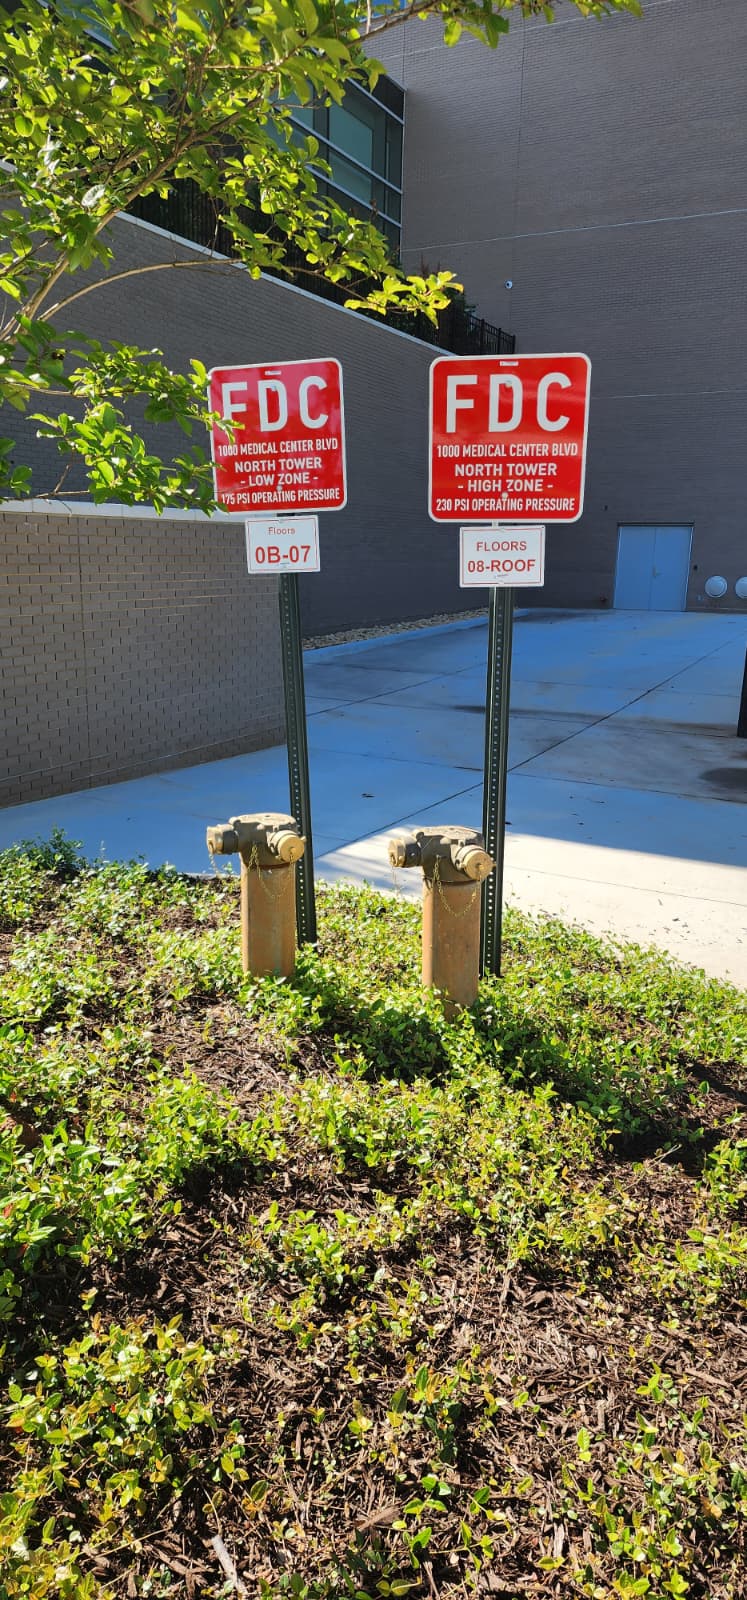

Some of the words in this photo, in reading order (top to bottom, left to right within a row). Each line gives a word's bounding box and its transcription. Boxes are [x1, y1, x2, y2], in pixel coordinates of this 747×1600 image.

[222, 376, 328, 432] FDC
[446, 372, 572, 433] FDC
[218, 445, 238, 456] 1000
[240, 441, 278, 455] MEDICAL
[280, 439, 314, 453] CENTER
[316, 438, 338, 450] BLVD
[437, 445, 460, 457] 1000
[462, 444, 506, 457] MEDICAL
[509, 443, 548, 456] CENTER
[552, 443, 578, 456] BLVD
[235, 460, 276, 473] NORTH
[278, 457, 322, 470] TOWER
[455, 463, 503, 476] NORTH
[506, 463, 557, 476] TOWER
[249, 473, 275, 486] LOW
[277, 472, 310, 485] ZONE
[468, 479, 502, 492] HIGH
[506, 479, 544, 492] ZONE
[221, 493, 235, 505] 175
[237, 493, 250, 504] PSI
[252, 490, 296, 503] OPERATING
[298, 488, 340, 501] PRESSURE
[436, 499, 452, 511] 230
[454, 499, 470, 511] PSI
[472, 498, 523, 511] OPERATING
[526, 498, 575, 511] PRESSURE
[268, 527, 296, 535] Floors
[476, 541, 527, 551] FLOORS
[255, 545, 311, 564] 0B-07
[467, 559, 536, 573] 08-ROOF
